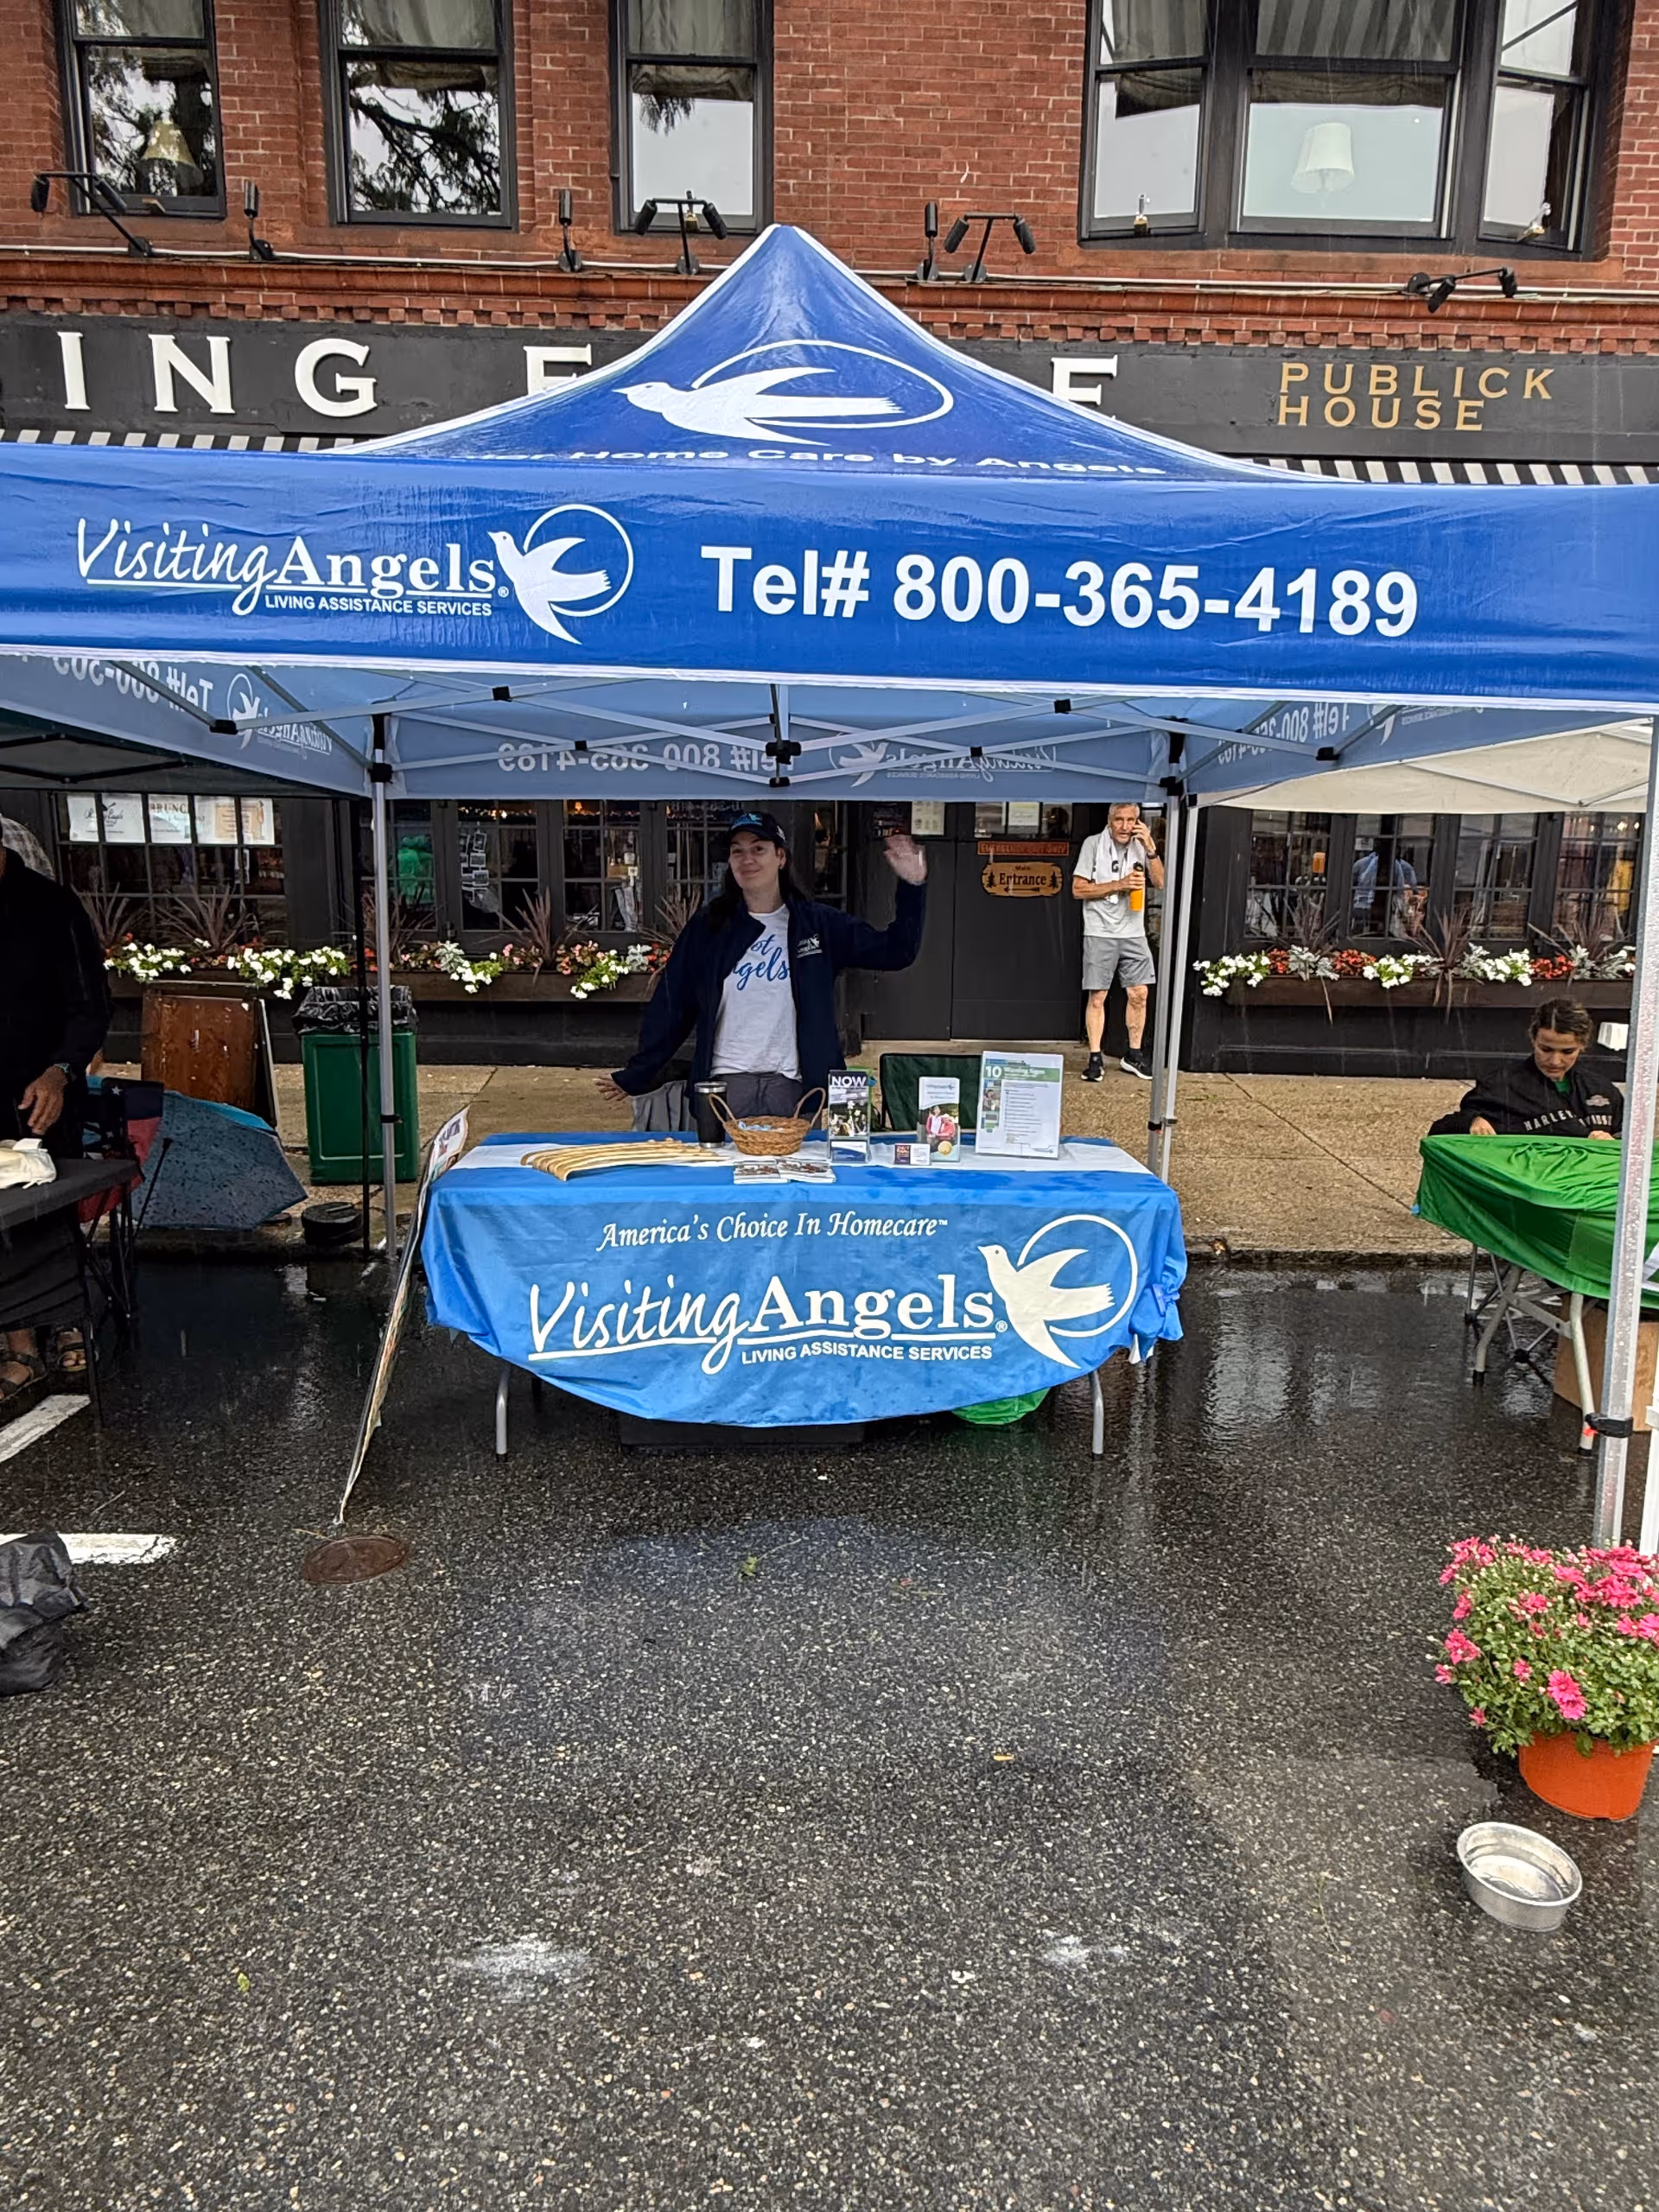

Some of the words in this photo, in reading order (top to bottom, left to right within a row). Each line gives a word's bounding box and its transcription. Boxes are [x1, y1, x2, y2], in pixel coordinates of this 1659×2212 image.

[1280, 362, 1554, 400] PUBLICK
[1278, 395, 1485, 431] HOUSE
[569, 451, 729, 461] Home
[747, 448, 875, 463] Care
[893, 453, 957, 467] by
[976, 457, 1166, 475] Angels
[77, 518, 277, 616] Visiting
[702, 545, 870, 619] Tel#
[893, 555, 1419, 638] 800-365-4189
[265, 594, 315, 611] LIVING
[318, 596, 414, 614] ASSISTANCE
[416, 600, 493, 617] SERVICES
[999, 872, 1047, 886] Entrance
[750, 933, 776, 956] ot
[831, 1076, 868, 1088] NOW
[985, 1065, 1002, 1078] 10
[595, 1214, 709, 1253] America's
[716, 1211, 790, 1243] Choice
[794, 1212, 821, 1236] In
[530, 1274, 750, 1376] Visiting
[741, 1346, 797, 1365] LIVING
[800, 1342, 906, 1362] ASSISTANCE
[908, 1345, 994, 1361] SERVICES
